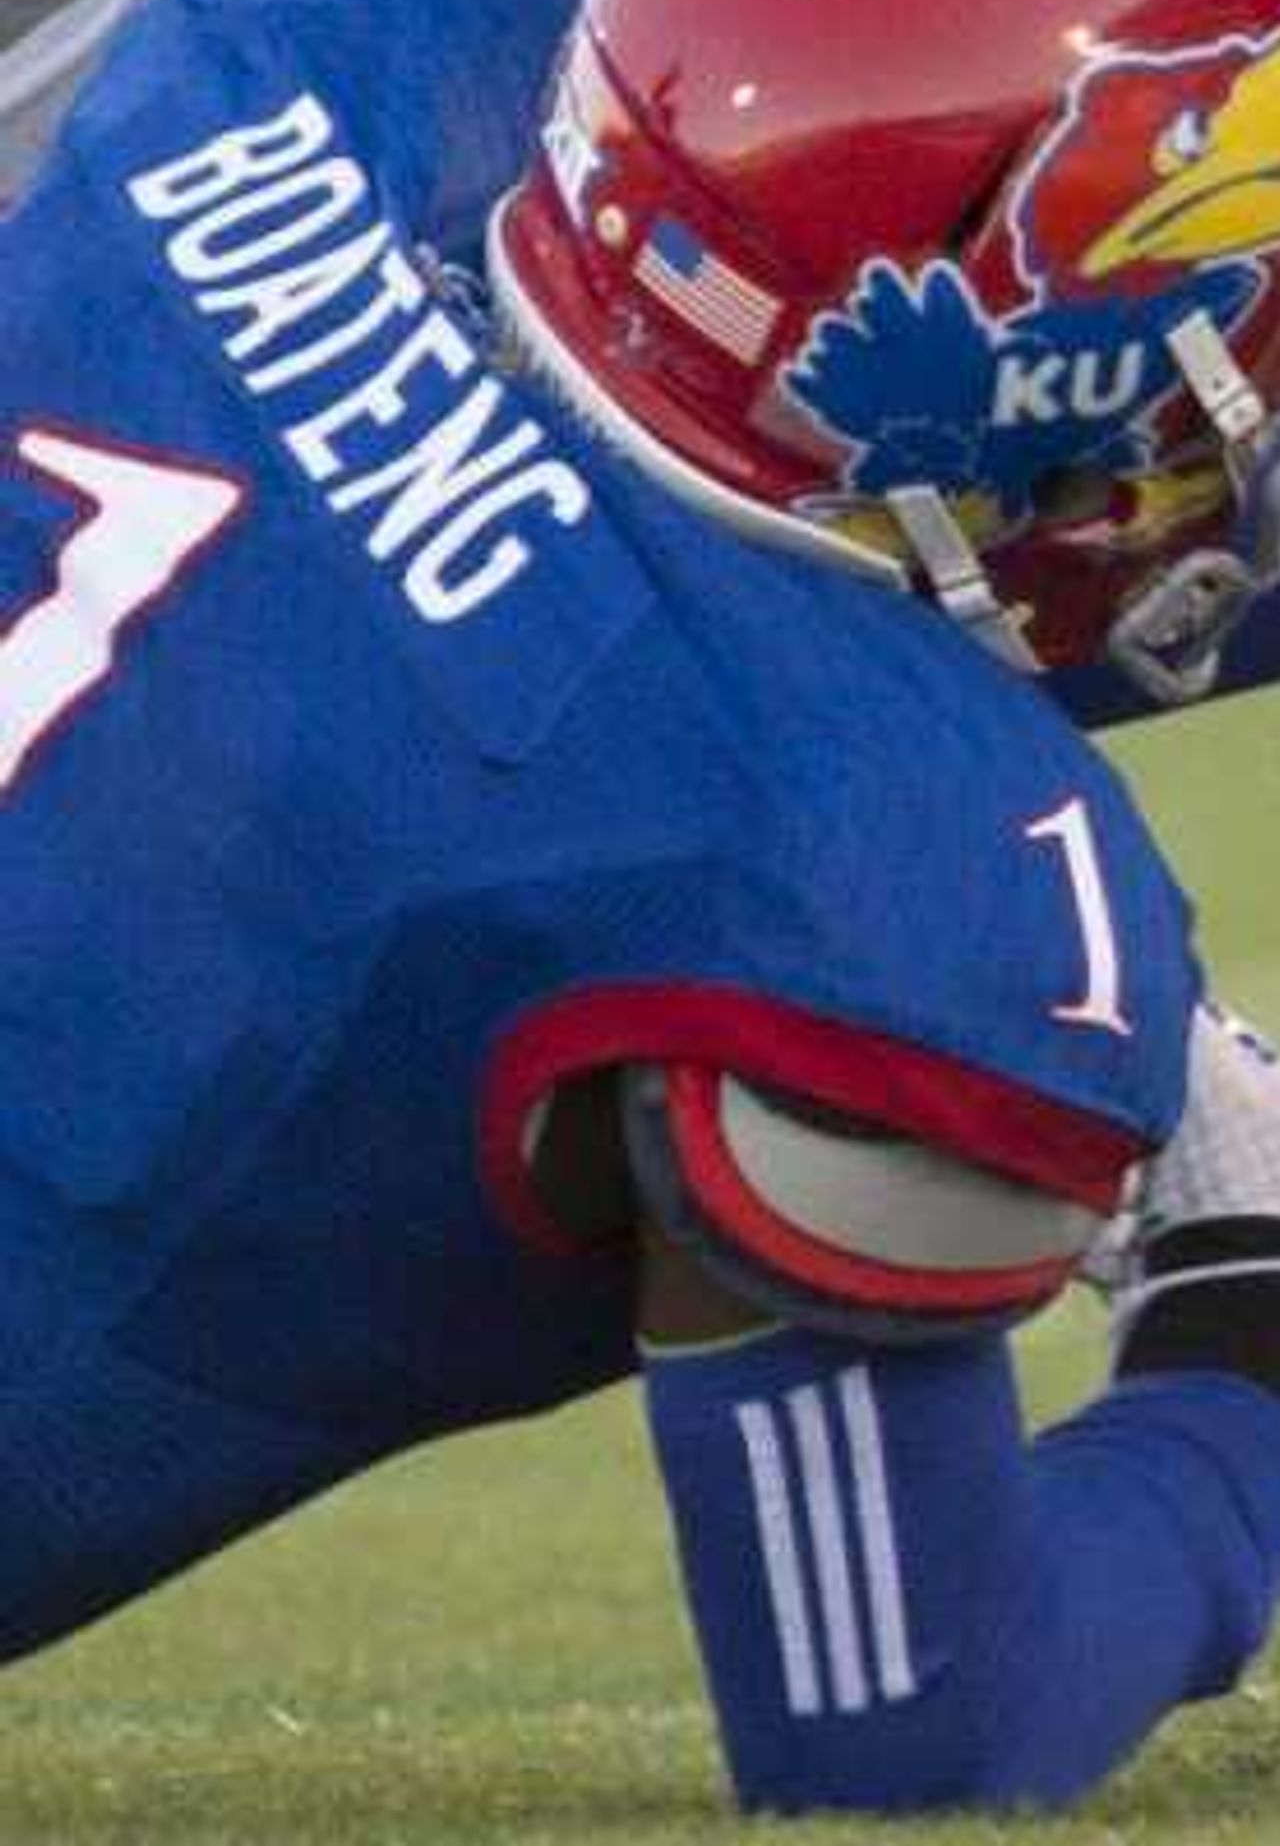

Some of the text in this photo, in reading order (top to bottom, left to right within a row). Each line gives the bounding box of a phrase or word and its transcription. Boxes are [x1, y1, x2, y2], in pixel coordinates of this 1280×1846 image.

[127, 92, 592, 625] BOATENG
[992, 341, 1146, 427] KU
[1025, 798, 1133, 1037] 1
